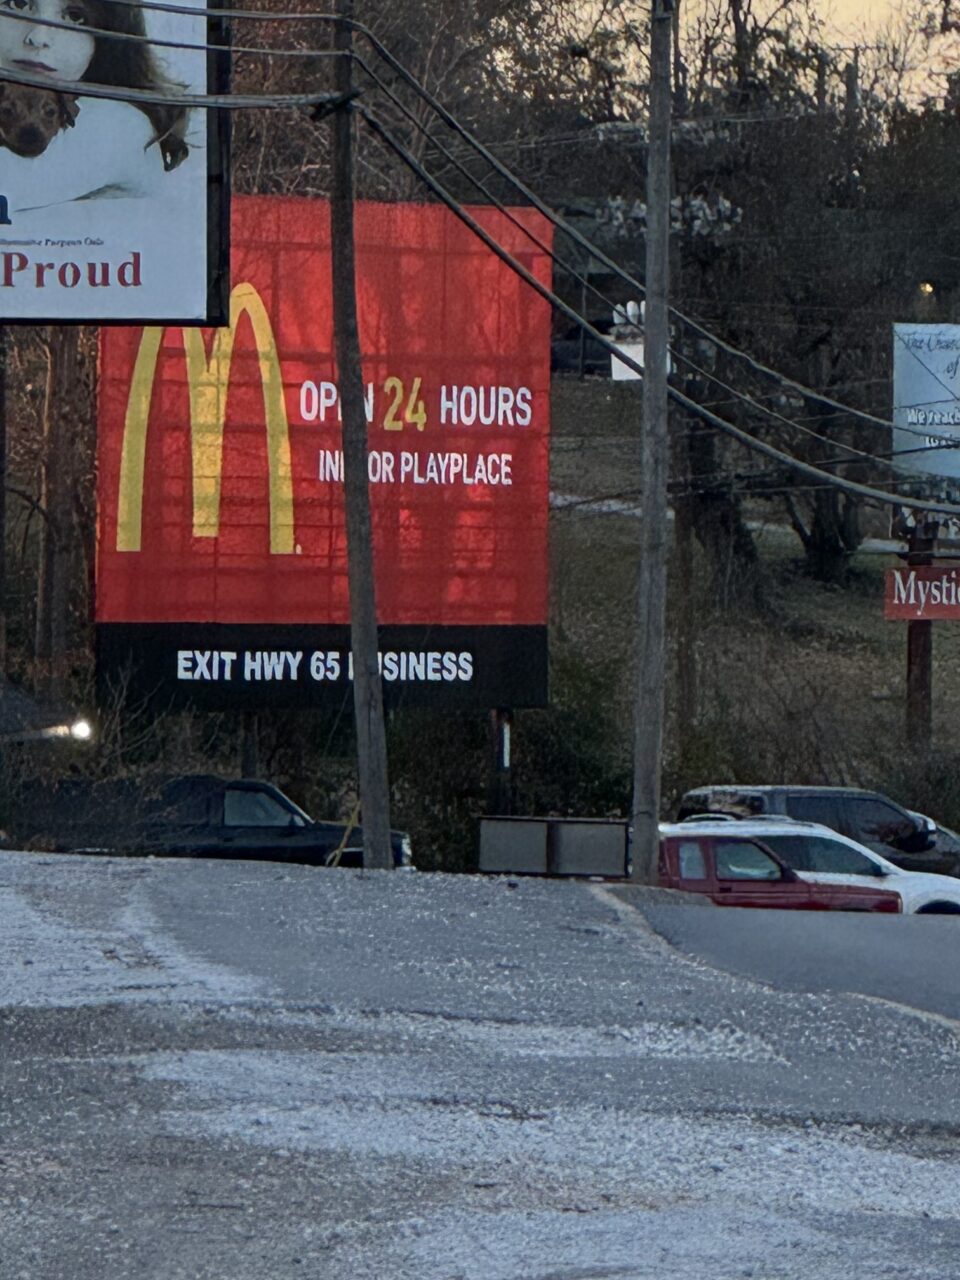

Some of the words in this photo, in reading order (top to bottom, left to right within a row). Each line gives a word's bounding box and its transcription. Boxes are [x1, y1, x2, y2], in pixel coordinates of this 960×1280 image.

[383, 376, 427, 431] 24
[440, 384, 533, 426] HOURS
[400, 452, 513, 486] PLAYPLACE
[177, 650, 237, 680] EXIT
[244, 650, 303, 681] HWY
[310, 651, 340, 681] 65
